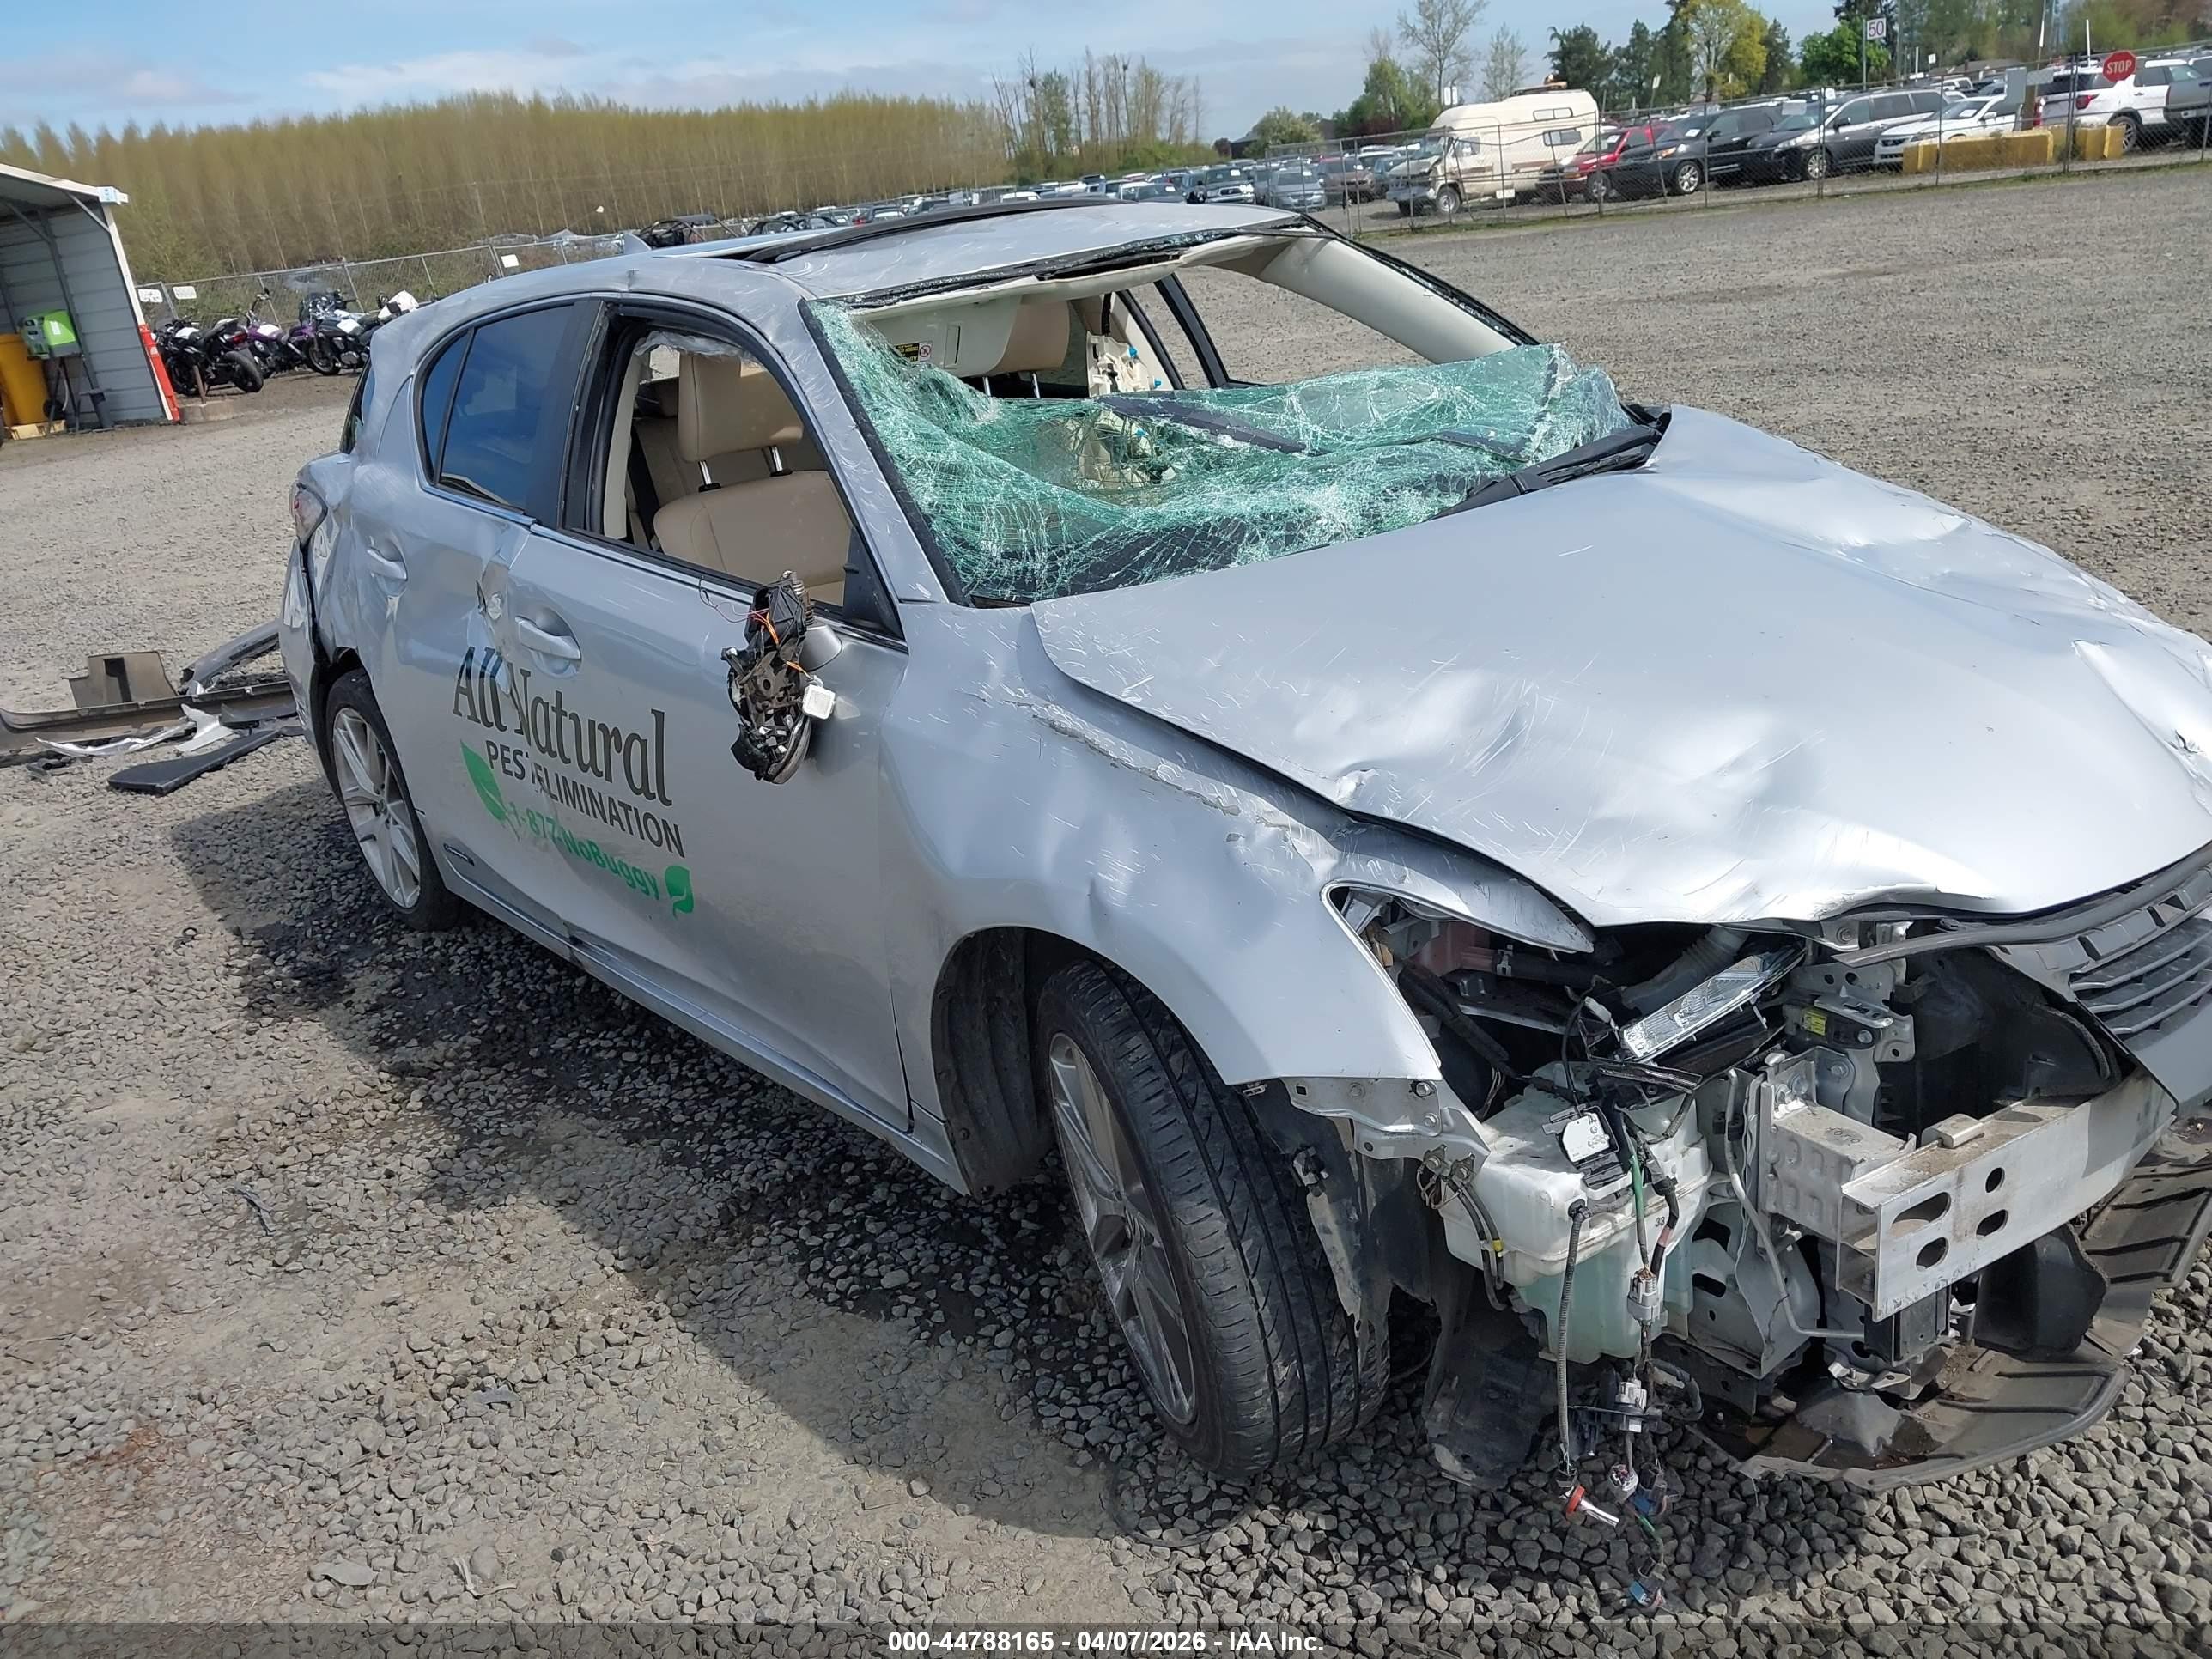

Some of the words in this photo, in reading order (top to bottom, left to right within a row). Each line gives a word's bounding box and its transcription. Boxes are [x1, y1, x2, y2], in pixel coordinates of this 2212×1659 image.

[1869, 21, 1884, 37] 50
[2106, 59, 2132, 75] STOP
[453, 647, 507, 732] All
[507, 661, 673, 807] Natural
[533, 762, 686, 859] ELIMINATION
